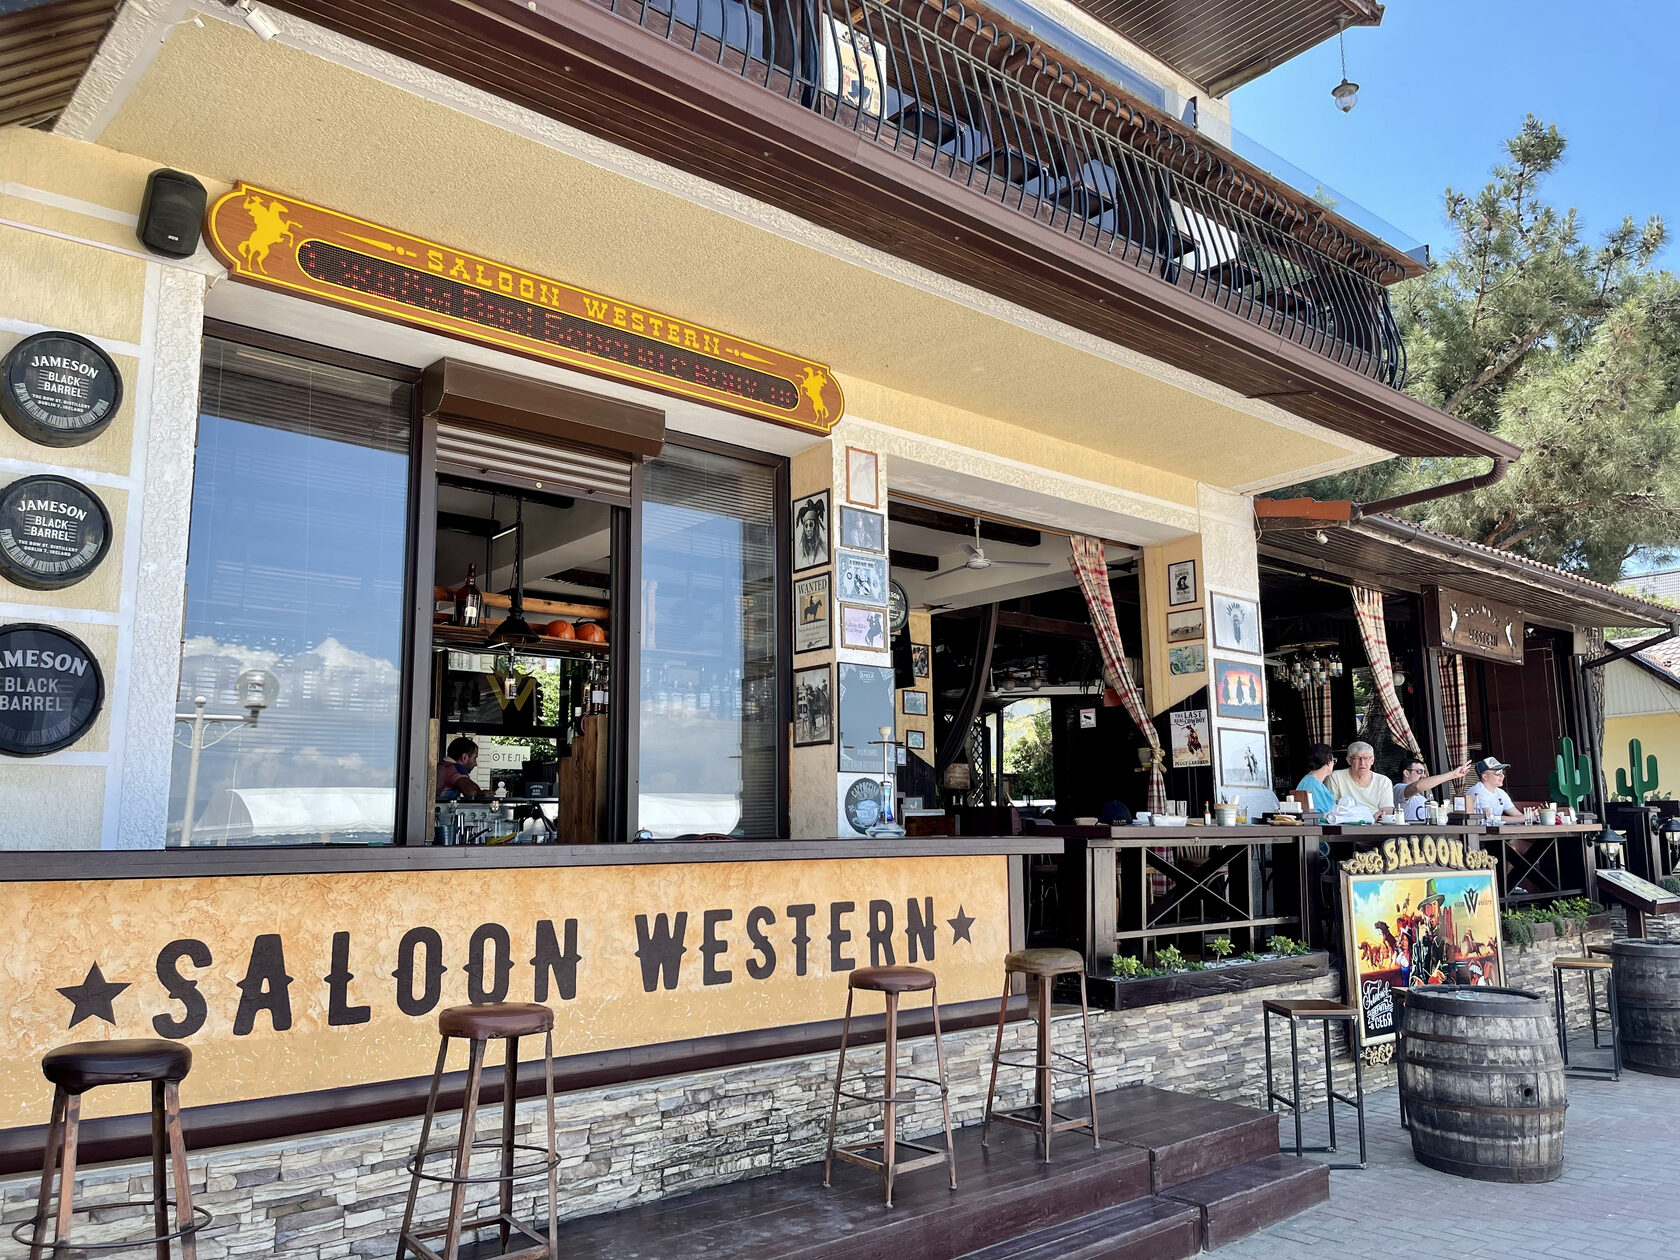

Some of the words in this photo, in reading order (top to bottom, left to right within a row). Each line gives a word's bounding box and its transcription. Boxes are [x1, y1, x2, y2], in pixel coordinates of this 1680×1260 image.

[427, 249, 560, 307] SALOON
[583, 296, 720, 355] WESTERN
[31, 355, 99, 379] JAMESON
[48, 371, 81, 387] BLACK
[44, 381, 83, 398] BARREL
[18, 499, 88, 522] JAMESON
[35, 515, 69, 530] BLACK
[30, 526, 70, 541] BARREL
[797, 578, 827, 595] WANTED
[4, 676, 60, 694] BLACK
[0, 695, 64, 712] BARREL
[1184, 710, 1203, 719] LAST
[492, 753, 528, 762] ОТЕЛЬ
[1384, 835, 1465, 871] SALOON
[152, 918, 582, 1039] SALOON
[634, 896, 937, 992] WESTERN
[1374, 1012, 1393, 1029] СЕБЯ
